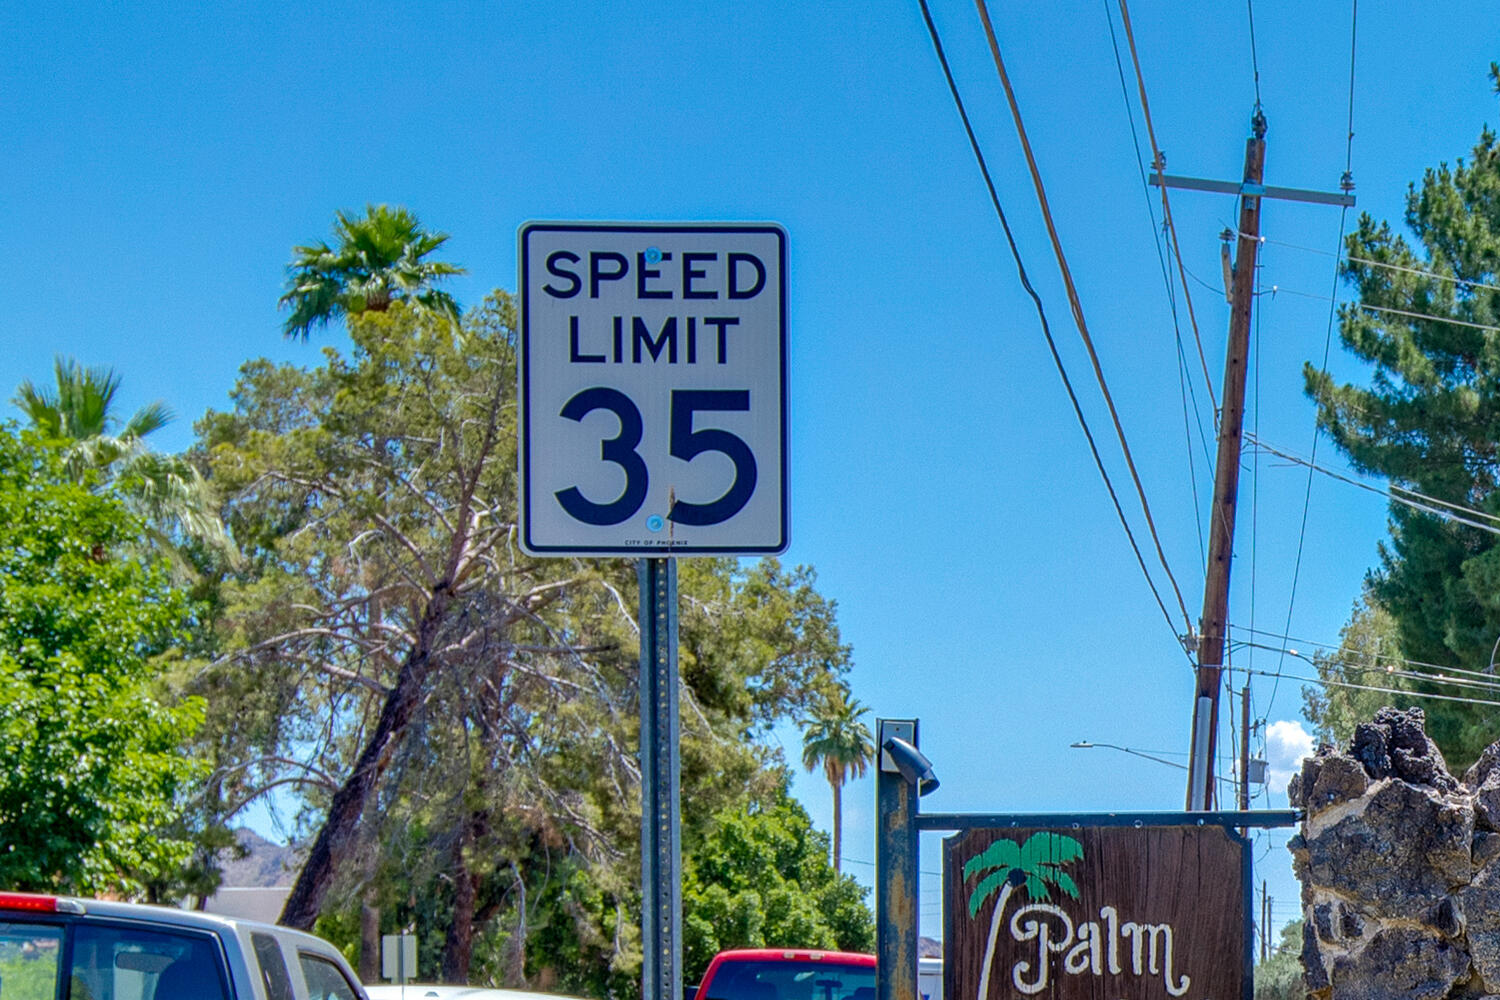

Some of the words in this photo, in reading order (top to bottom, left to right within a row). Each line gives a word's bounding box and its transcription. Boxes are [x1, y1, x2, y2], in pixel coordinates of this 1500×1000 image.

[542, 250, 767, 300] SPEED
[569, 315, 740, 365] LIMIT
[553, 386, 759, 527] 35
[1010, 903, 1191, 997] Palm
